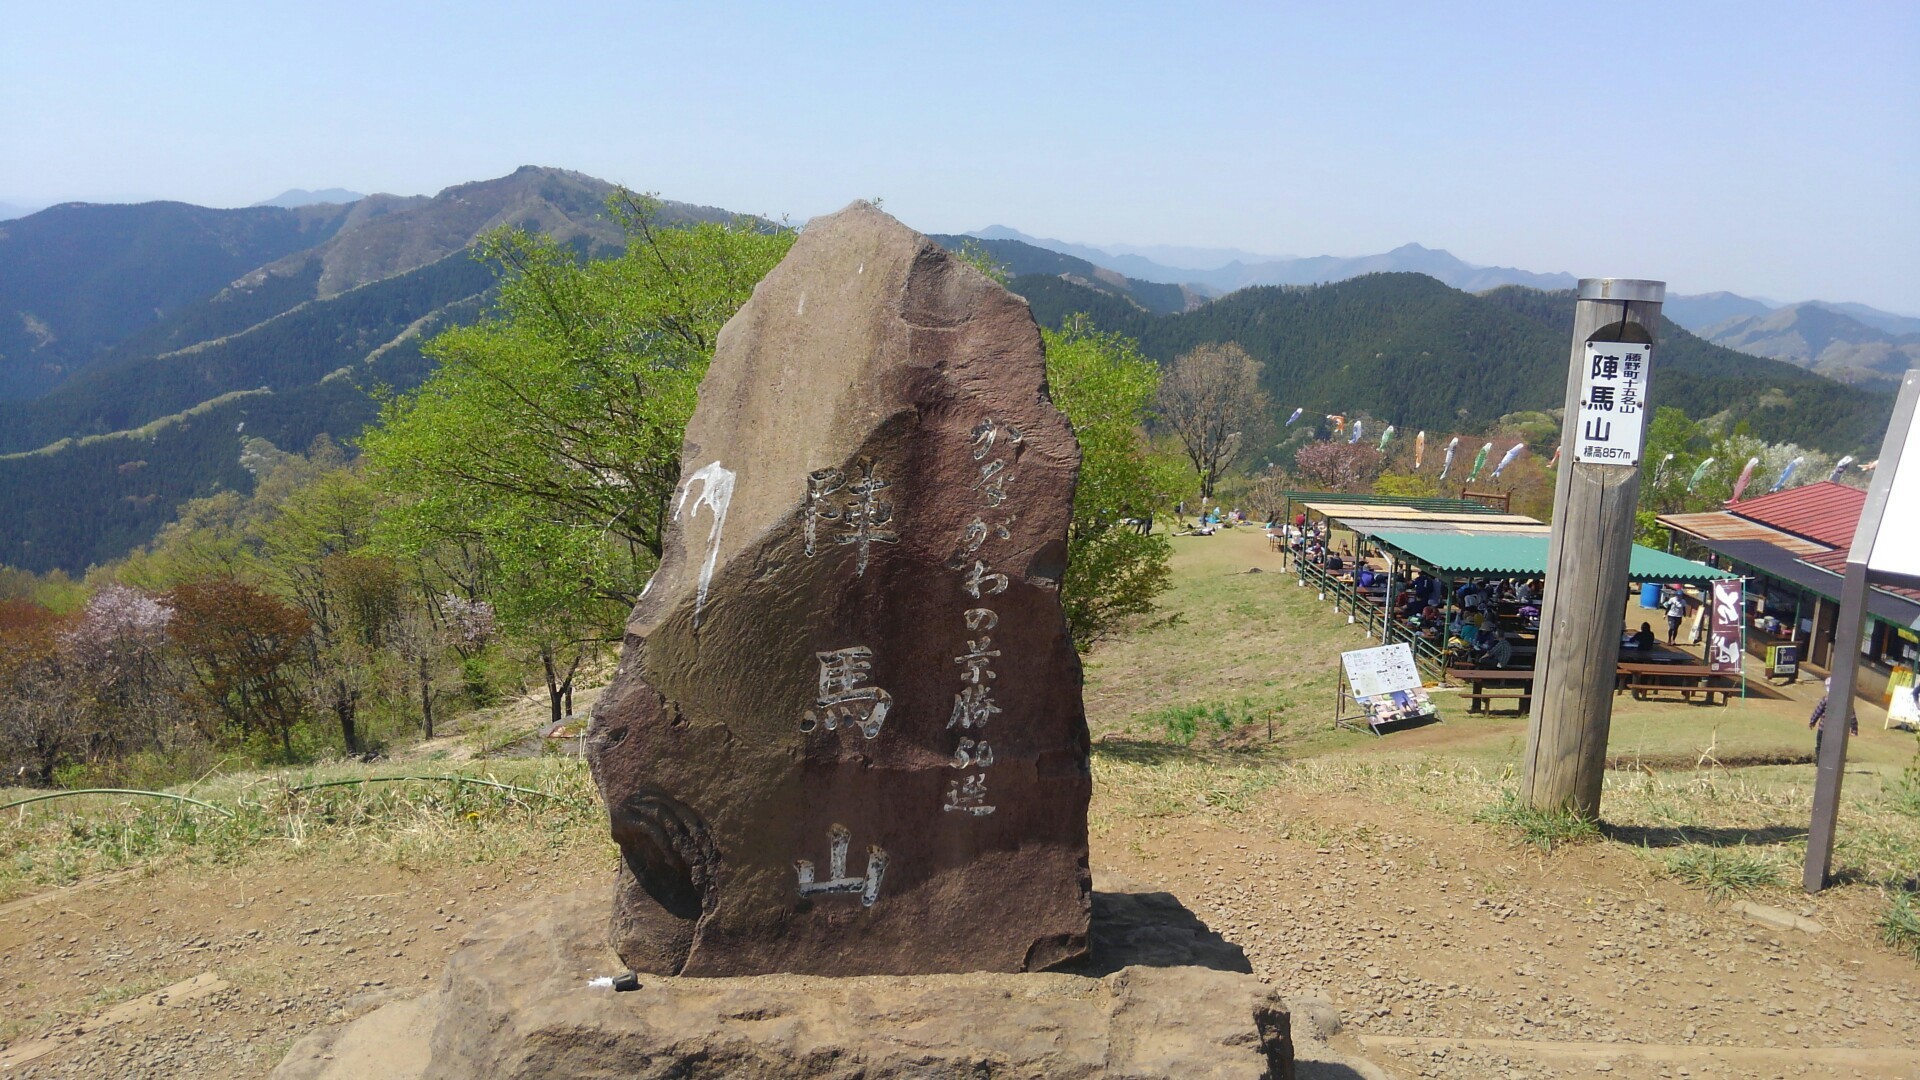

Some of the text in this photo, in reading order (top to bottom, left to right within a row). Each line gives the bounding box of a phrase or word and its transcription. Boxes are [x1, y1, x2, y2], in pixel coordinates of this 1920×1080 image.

[1585, 355, 1619, 442] 陣馬山
[1619, 353, 1642, 414] 藤野町十五名山
[1583, 446, 1631, 460] 標高857m
[794, 456, 900, 907] 陣馬山
